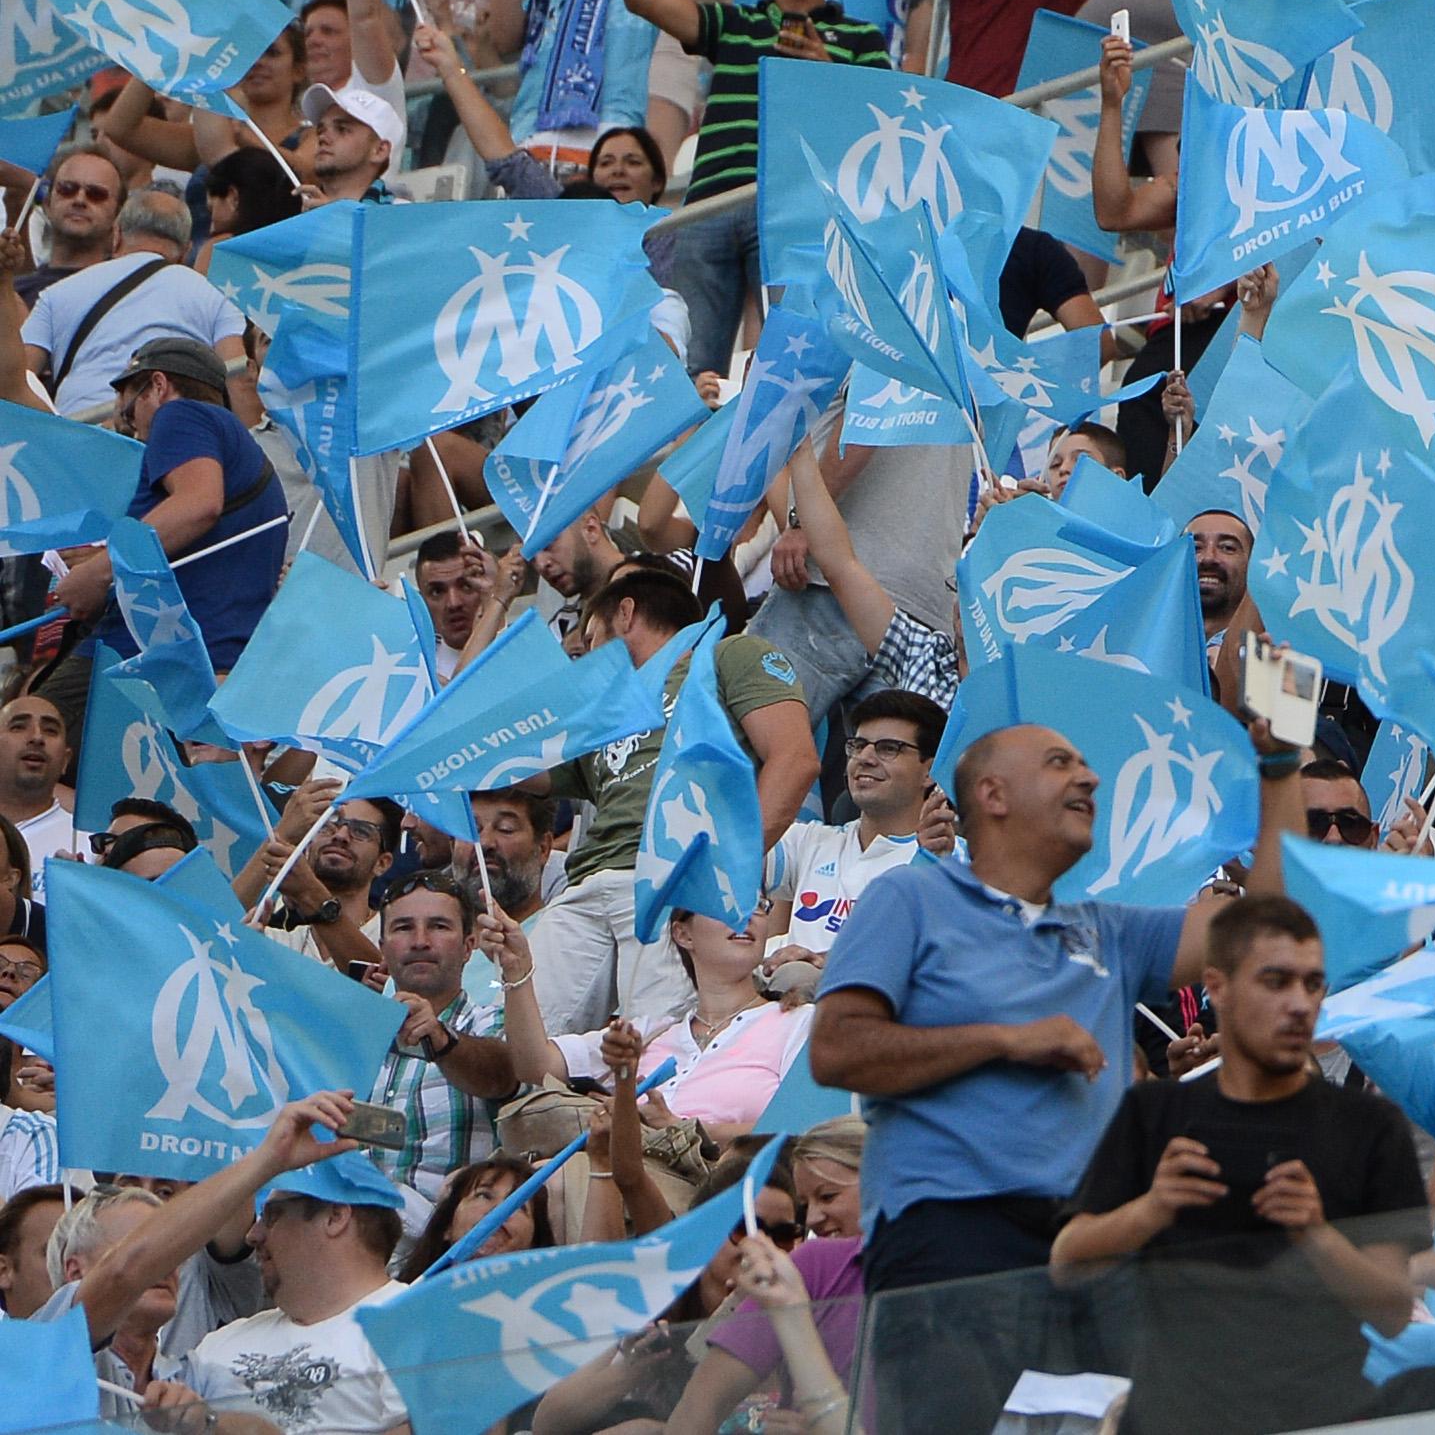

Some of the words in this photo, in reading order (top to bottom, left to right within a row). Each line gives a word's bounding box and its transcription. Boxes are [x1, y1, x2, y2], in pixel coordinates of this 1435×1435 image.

[206, 45, 241, 80] BUT
[1232, 224, 1290, 263] DROIT
[1291, 207, 1326, 230] AU
[1328, 179, 1366, 212] BUT
[142, 1134, 231, 1161] DROIT
